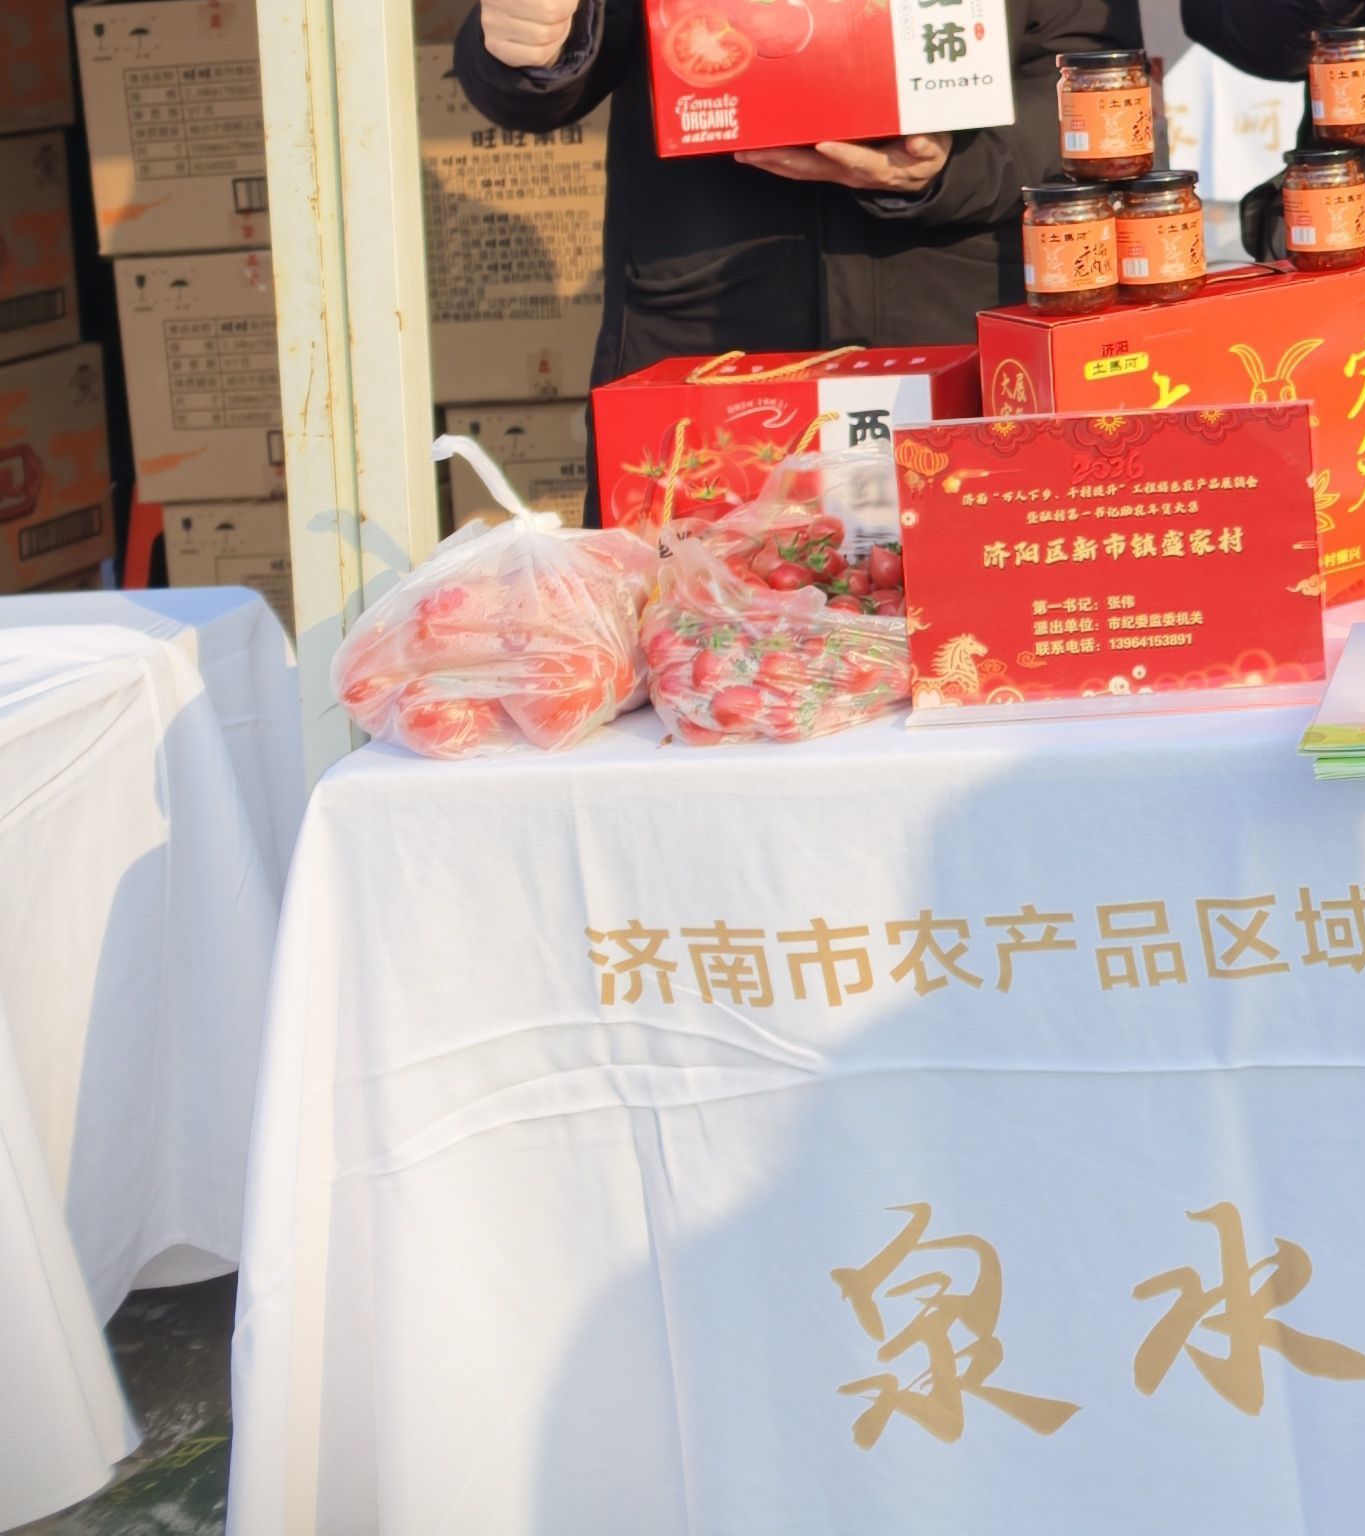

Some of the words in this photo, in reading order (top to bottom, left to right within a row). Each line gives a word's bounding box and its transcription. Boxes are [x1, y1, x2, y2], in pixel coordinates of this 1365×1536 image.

[909, 72, 994, 93] Tomato
[982, 525, 1245, 570] 济阳区新市镇盛家村
